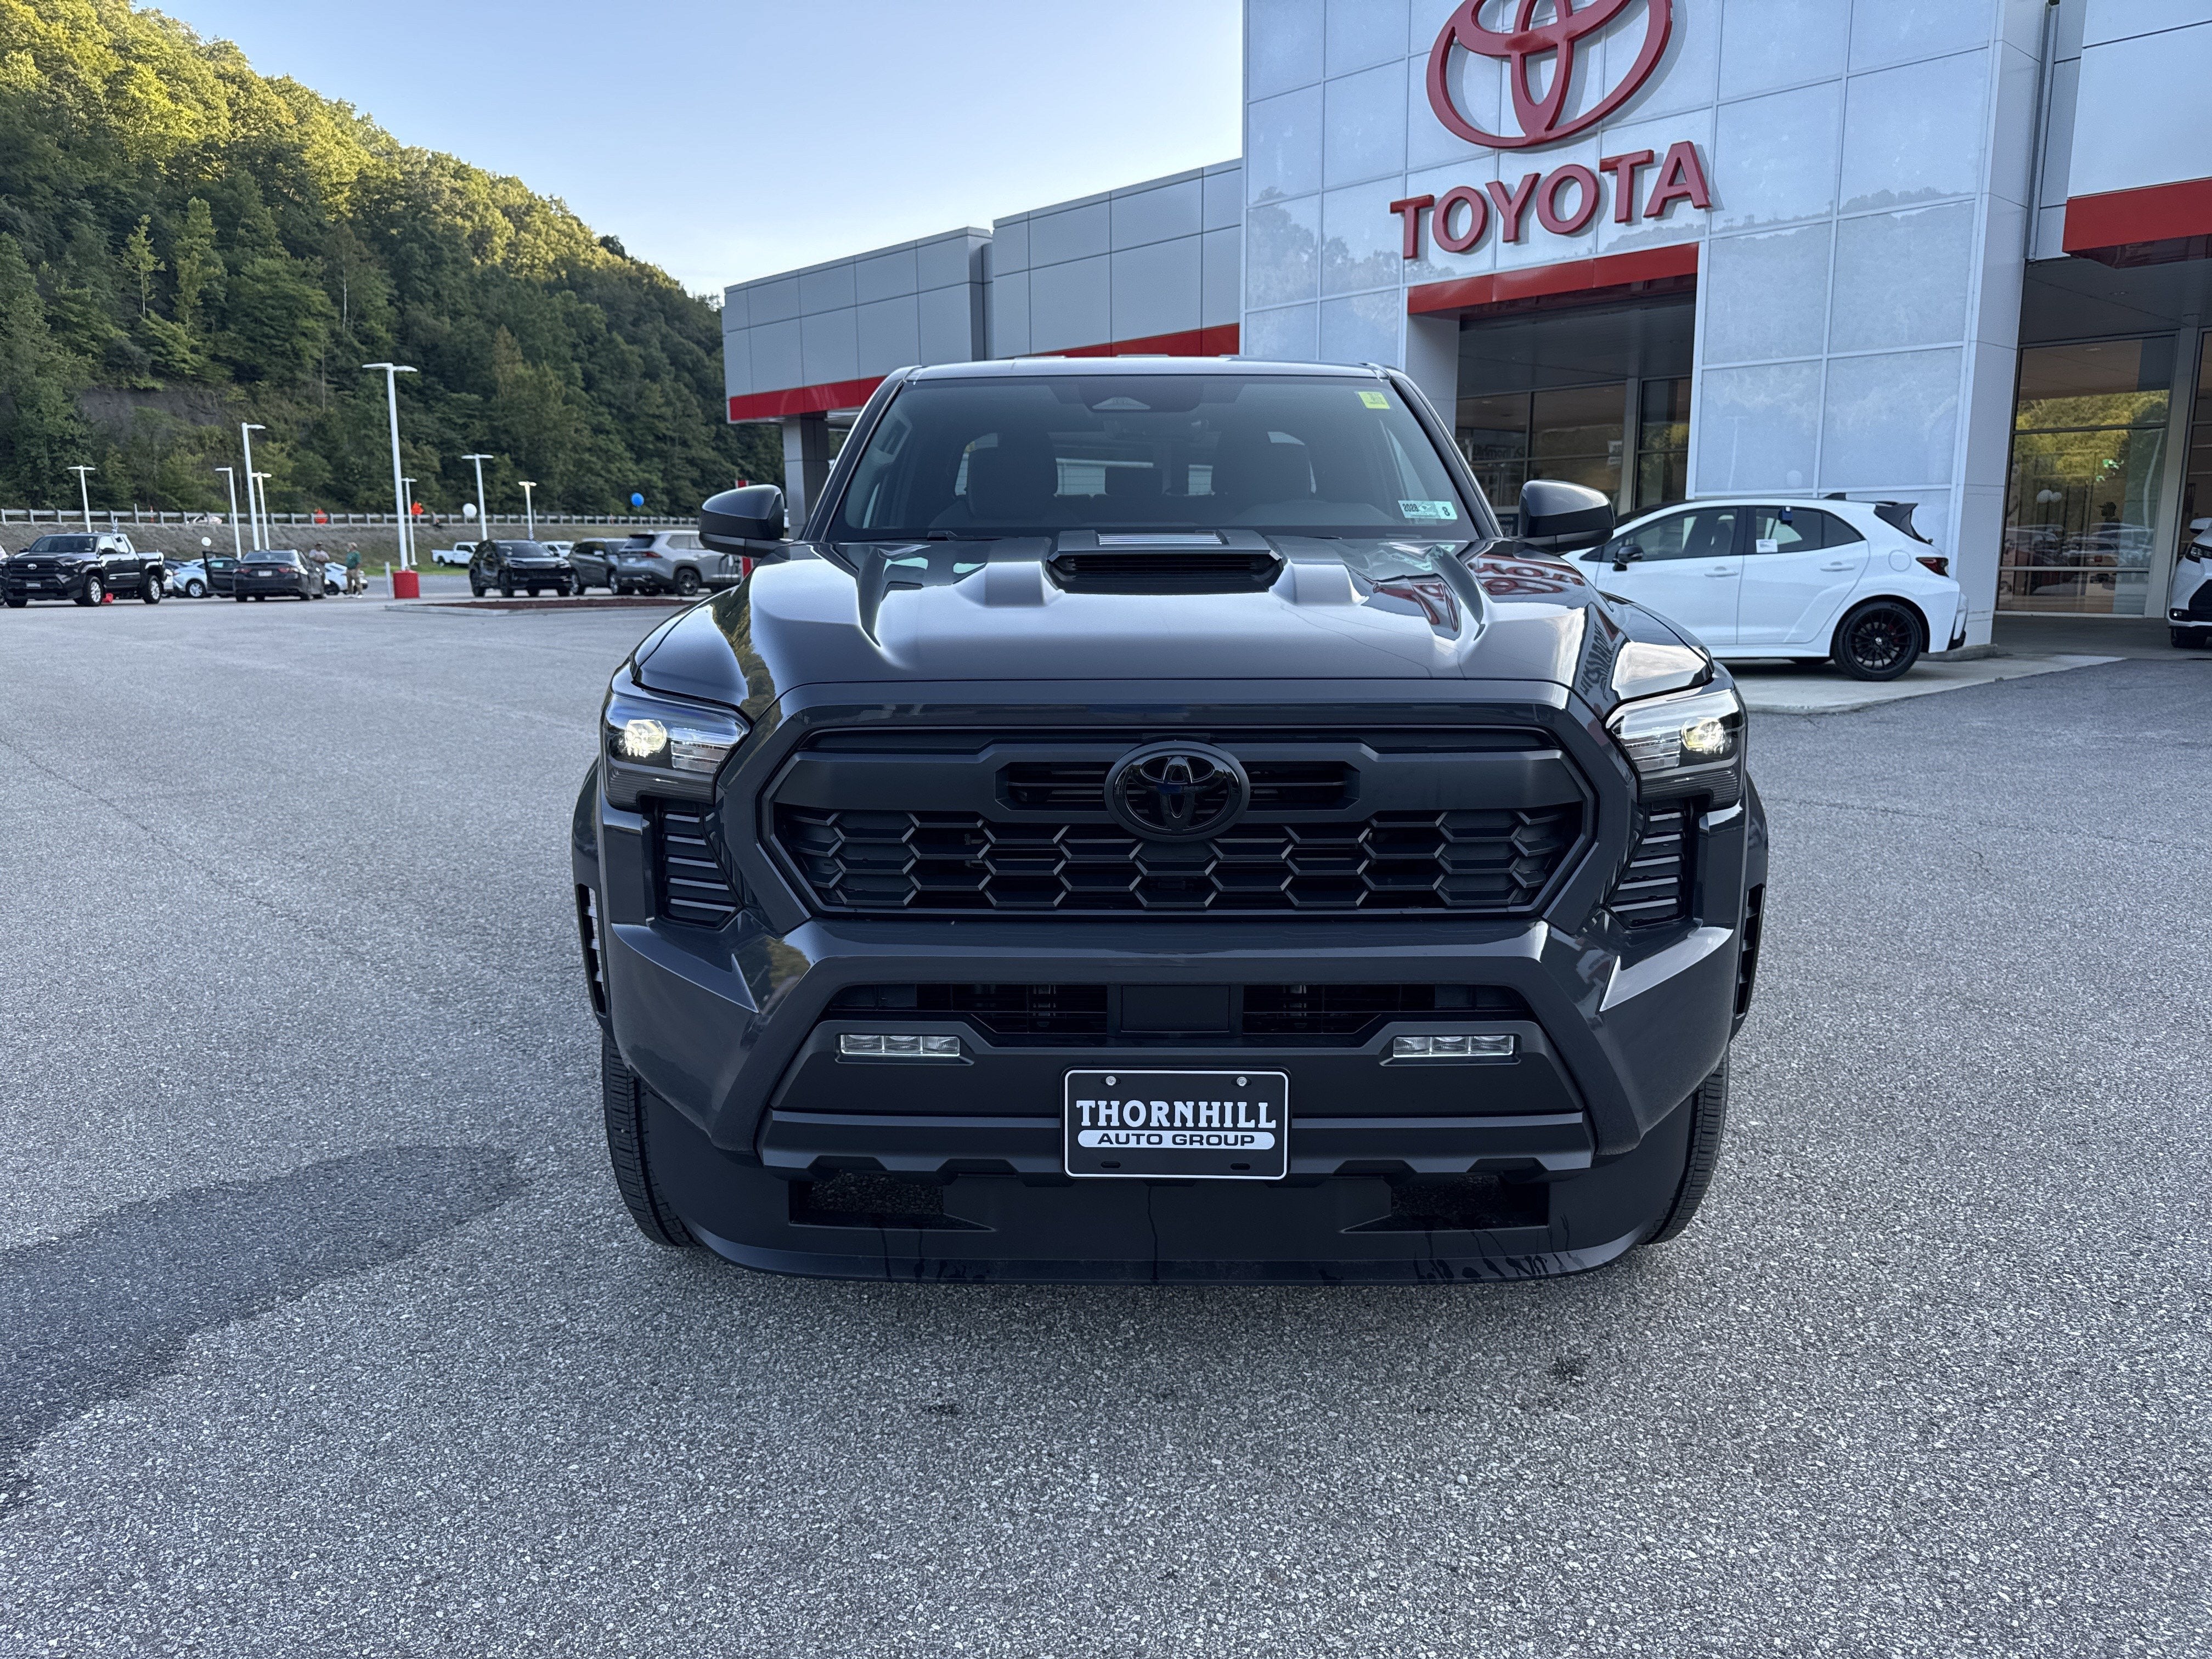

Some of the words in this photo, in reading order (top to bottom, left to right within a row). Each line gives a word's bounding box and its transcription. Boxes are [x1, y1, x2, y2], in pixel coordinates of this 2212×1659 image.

[1390, 141, 1711, 259] TOYOTA
[1442, 506, 1450, 516] 8
[1076, 1100, 1276, 1128] THORNHILL
[1097, 1133, 1163, 1146] AUTO
[1172, 1134, 1255, 1147] GROUP
